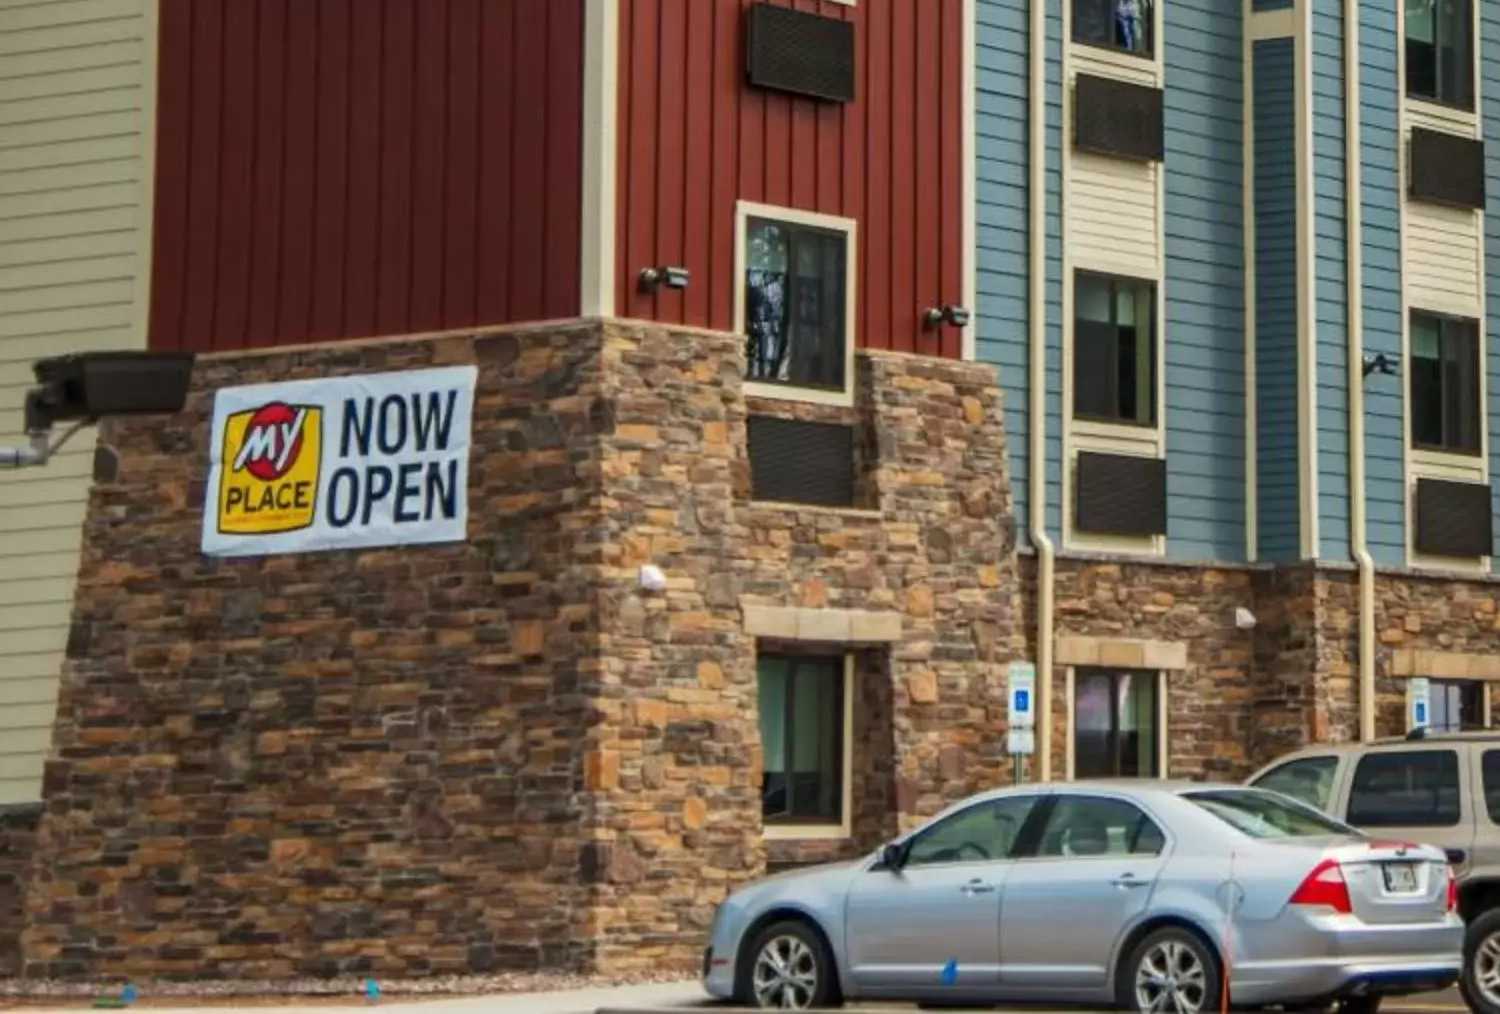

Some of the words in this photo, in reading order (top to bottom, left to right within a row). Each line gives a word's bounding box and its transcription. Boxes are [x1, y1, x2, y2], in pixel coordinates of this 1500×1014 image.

[339, 389, 458, 458] NOW
[225, 481, 311, 514] PLACE
[326, 459, 458, 527] OPEN
